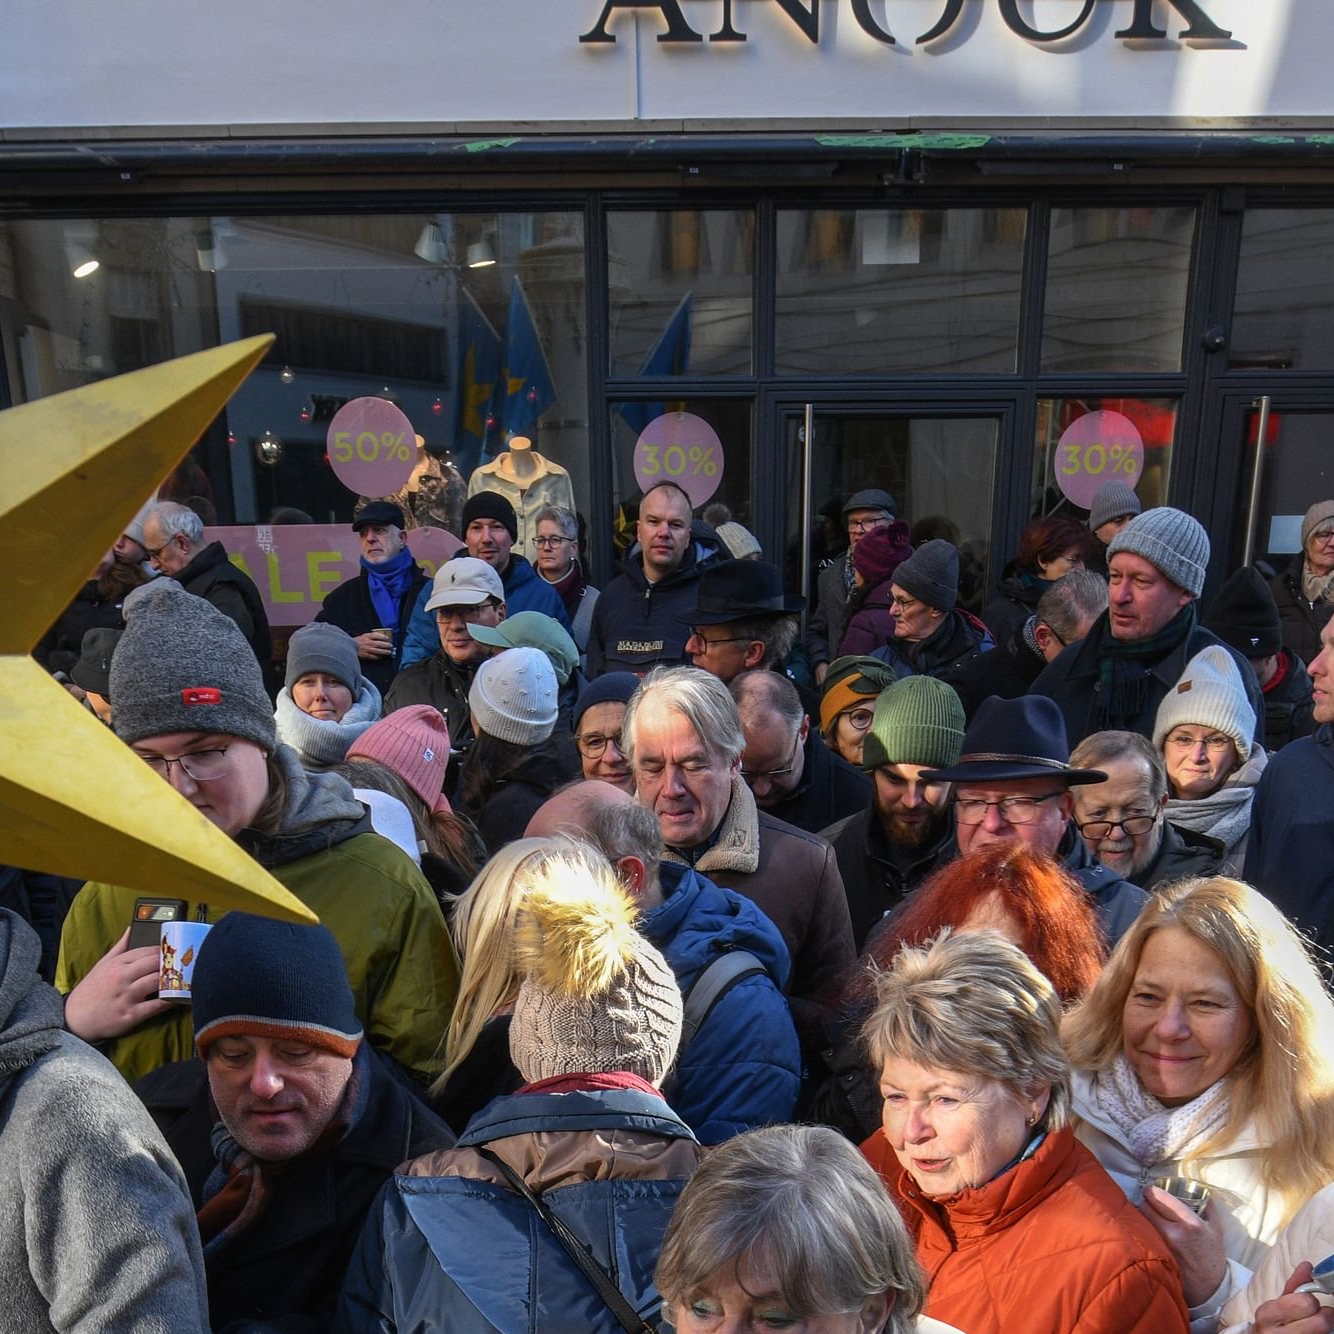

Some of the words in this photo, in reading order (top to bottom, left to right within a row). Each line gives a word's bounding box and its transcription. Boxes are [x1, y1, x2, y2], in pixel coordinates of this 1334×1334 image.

[333, 431, 411, 463] 50%
[641, 445, 718, 477] 30%
[1061, 443, 1137, 475] 30%
